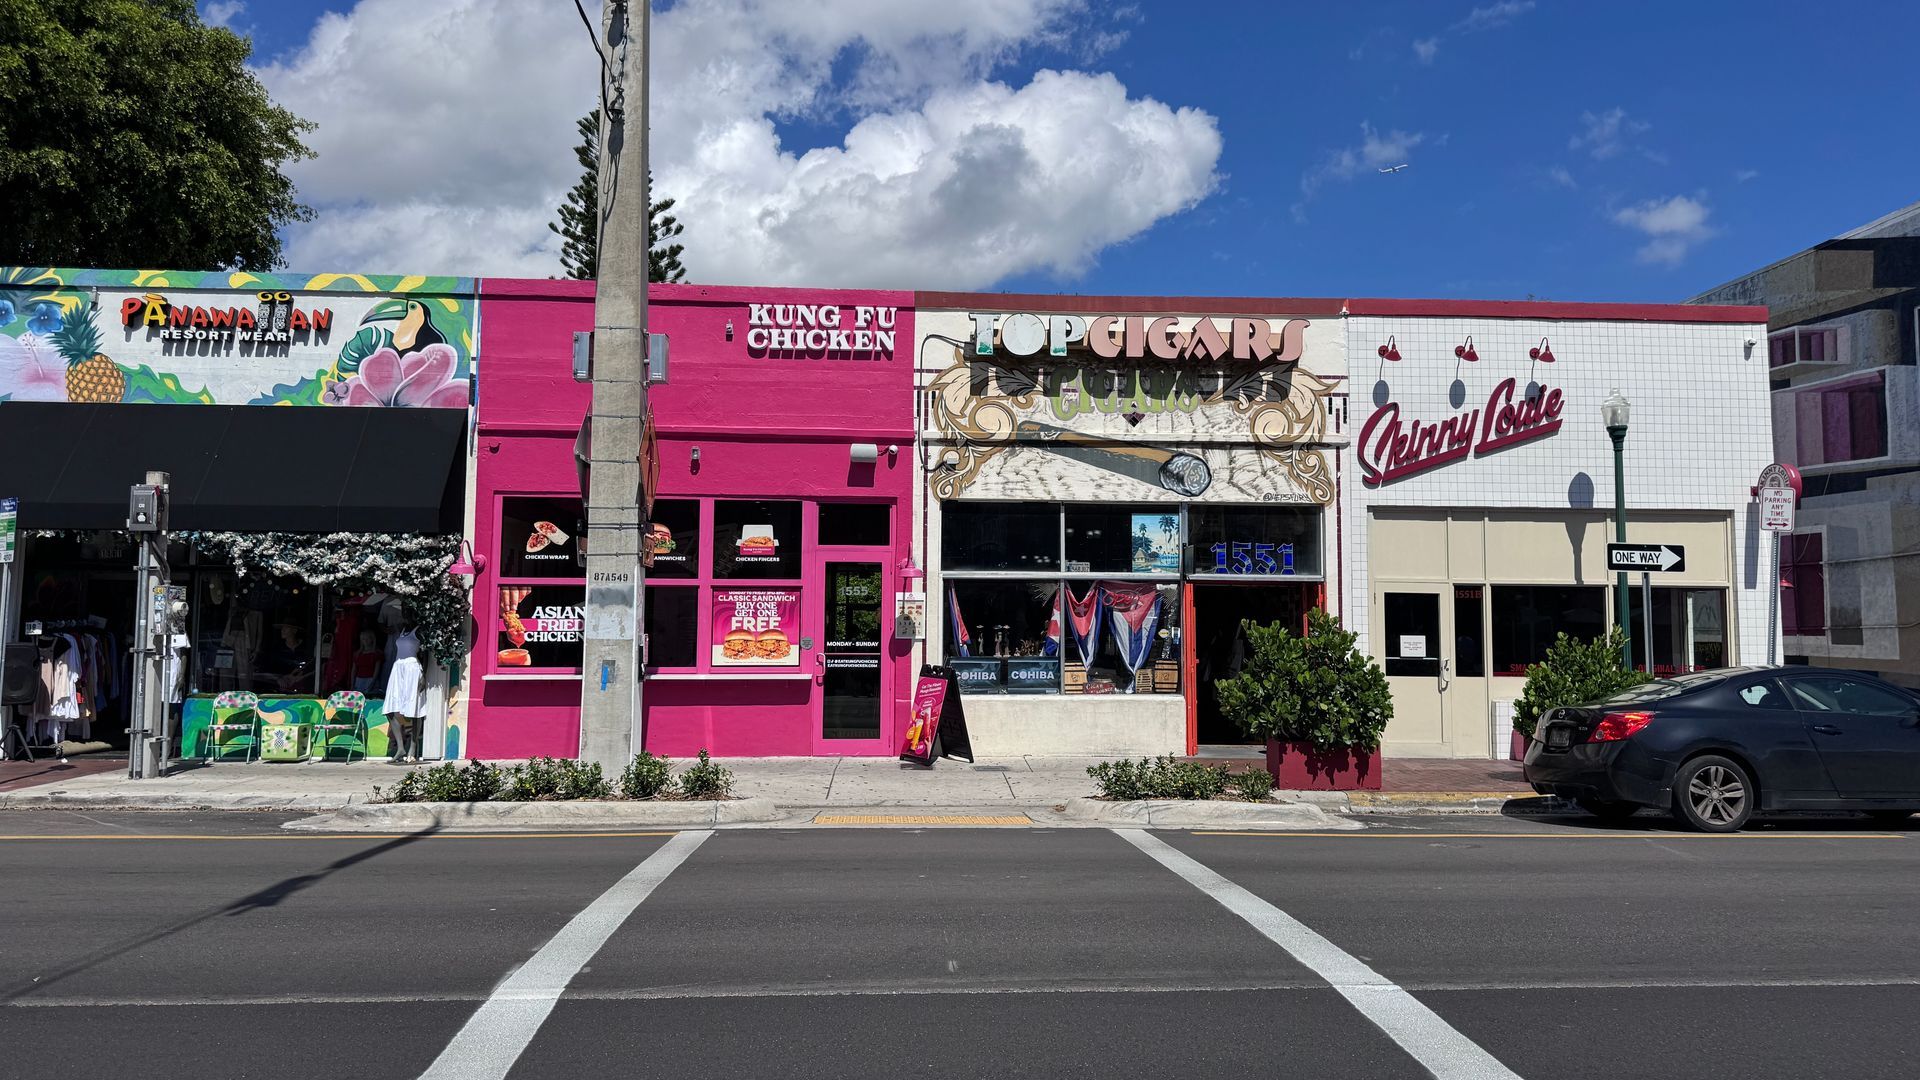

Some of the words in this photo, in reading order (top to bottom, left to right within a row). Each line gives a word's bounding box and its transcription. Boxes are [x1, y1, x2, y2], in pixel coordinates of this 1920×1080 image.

[121, 291, 329, 330] PANAWAIIAN
[749, 304, 841, 327] KUNG
[855, 306, 897, 328] FU
[160, 329, 231, 340] RESORT
[237, 331, 287, 342] WEAR
[747, 329, 897, 351] CHICKEN
[1357, 402, 1480, 484] Skinny
[1474, 377, 1565, 454] Louie
[1210, 541, 1296, 575] 1551
[1615, 552, 1636, 563] ONE
[1639, 553, 1661, 563] WAY
[594, 573, 629, 582] 87A549
[840, 586, 868, 596] 1555
[531, 606, 586, 619] ASIAN
[537, 619, 585, 631] FRIED
[731, 616, 781, 632] FREE
[524, 631, 585, 642] CHICKEN
[1011, 671, 1055, 680] COHIBA
